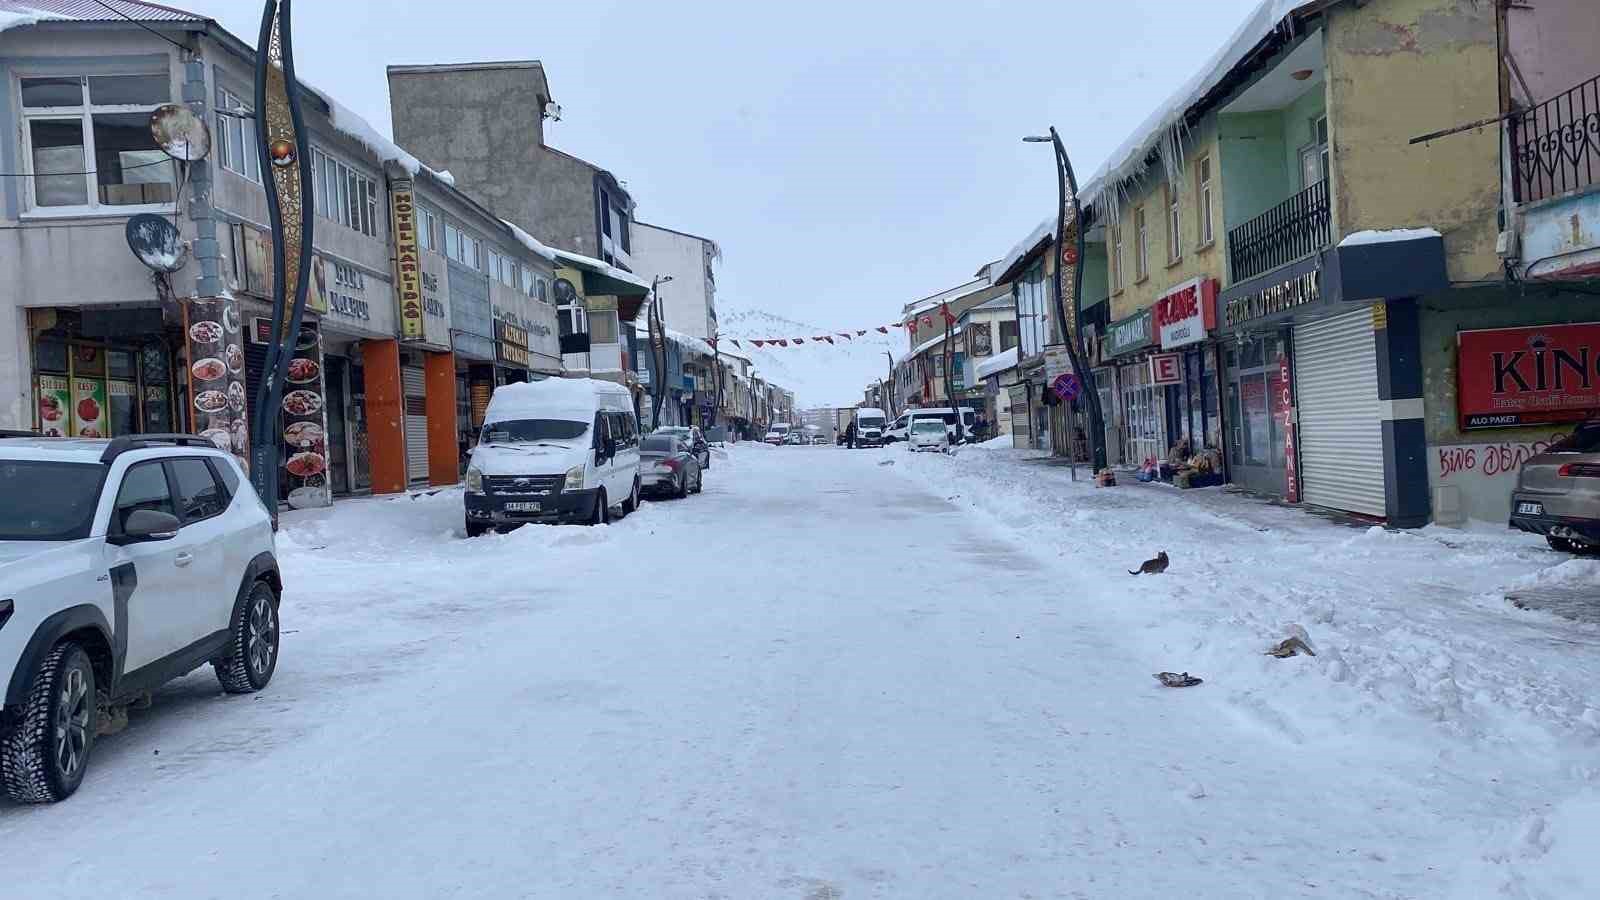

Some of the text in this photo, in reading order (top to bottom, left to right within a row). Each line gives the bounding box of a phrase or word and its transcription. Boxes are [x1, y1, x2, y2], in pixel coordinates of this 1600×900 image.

[396, 194, 412, 241] HOTEL
[1160, 359, 1175, 378] E
[1281, 366, 1296, 493] ECZANE
[1470, 415, 1516, 425] ALO PAKET
